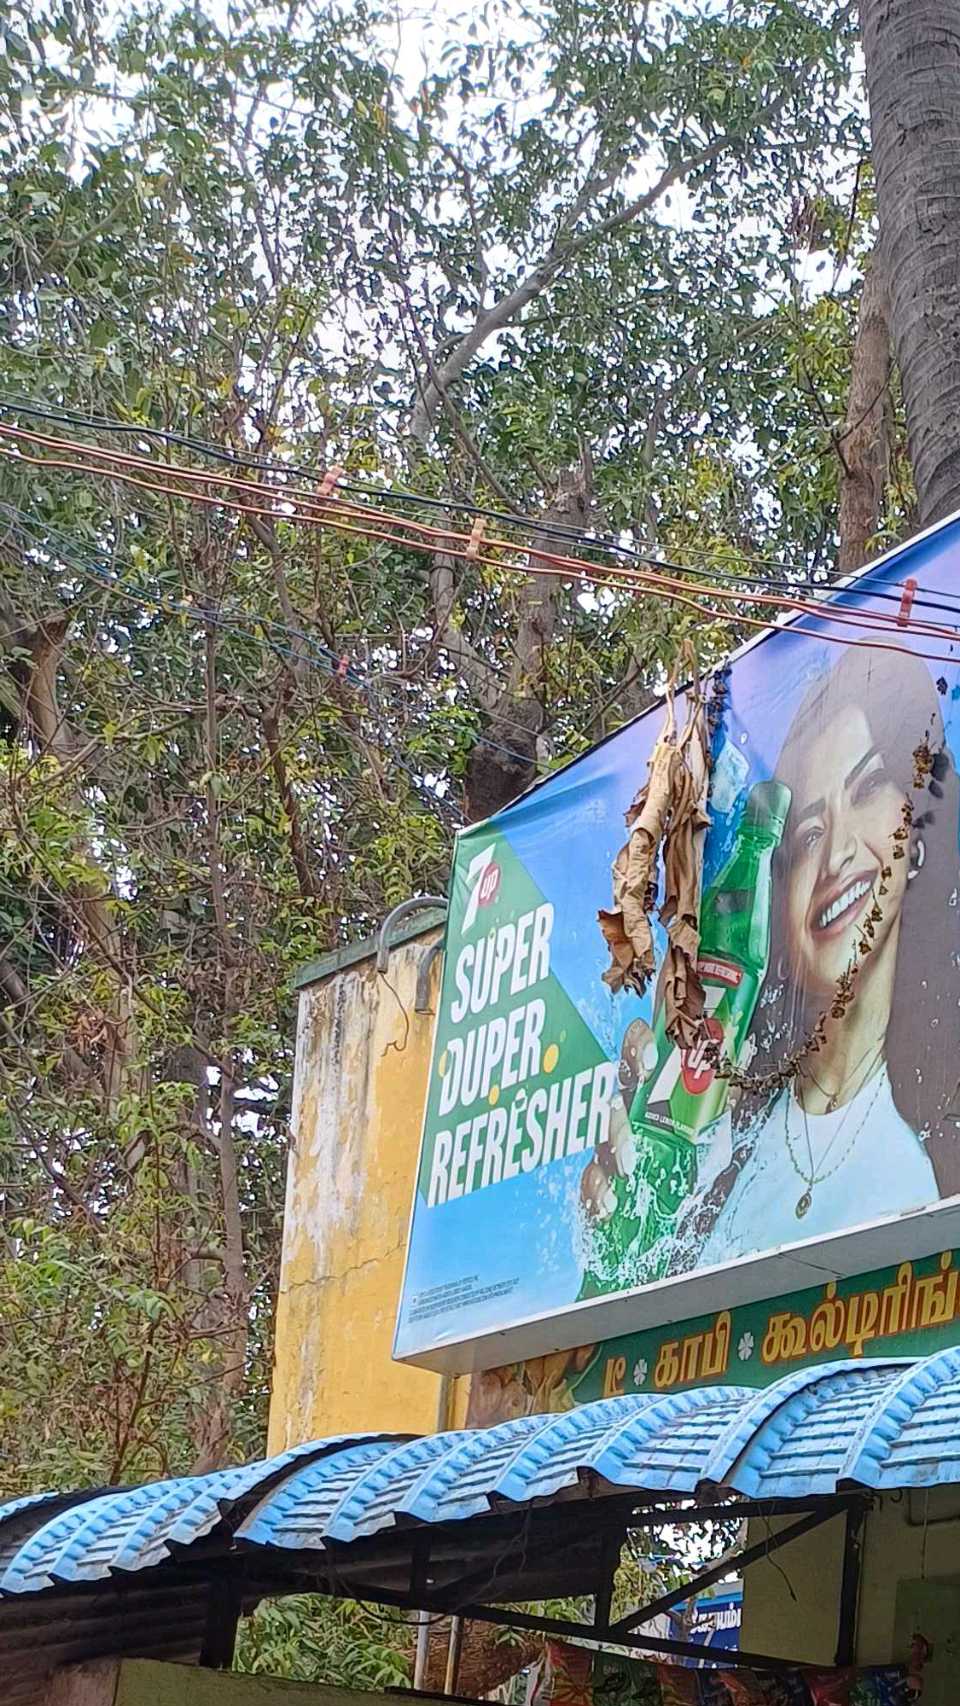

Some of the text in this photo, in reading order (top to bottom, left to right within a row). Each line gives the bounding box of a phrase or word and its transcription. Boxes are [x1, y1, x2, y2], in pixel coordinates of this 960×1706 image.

[450, 901, 555, 1024] SUPER
[438, 1001, 547, 1117] DUPER
[427, 1061, 616, 1208] REFRESHER
[654, 1310, 733, 1389] காபி
